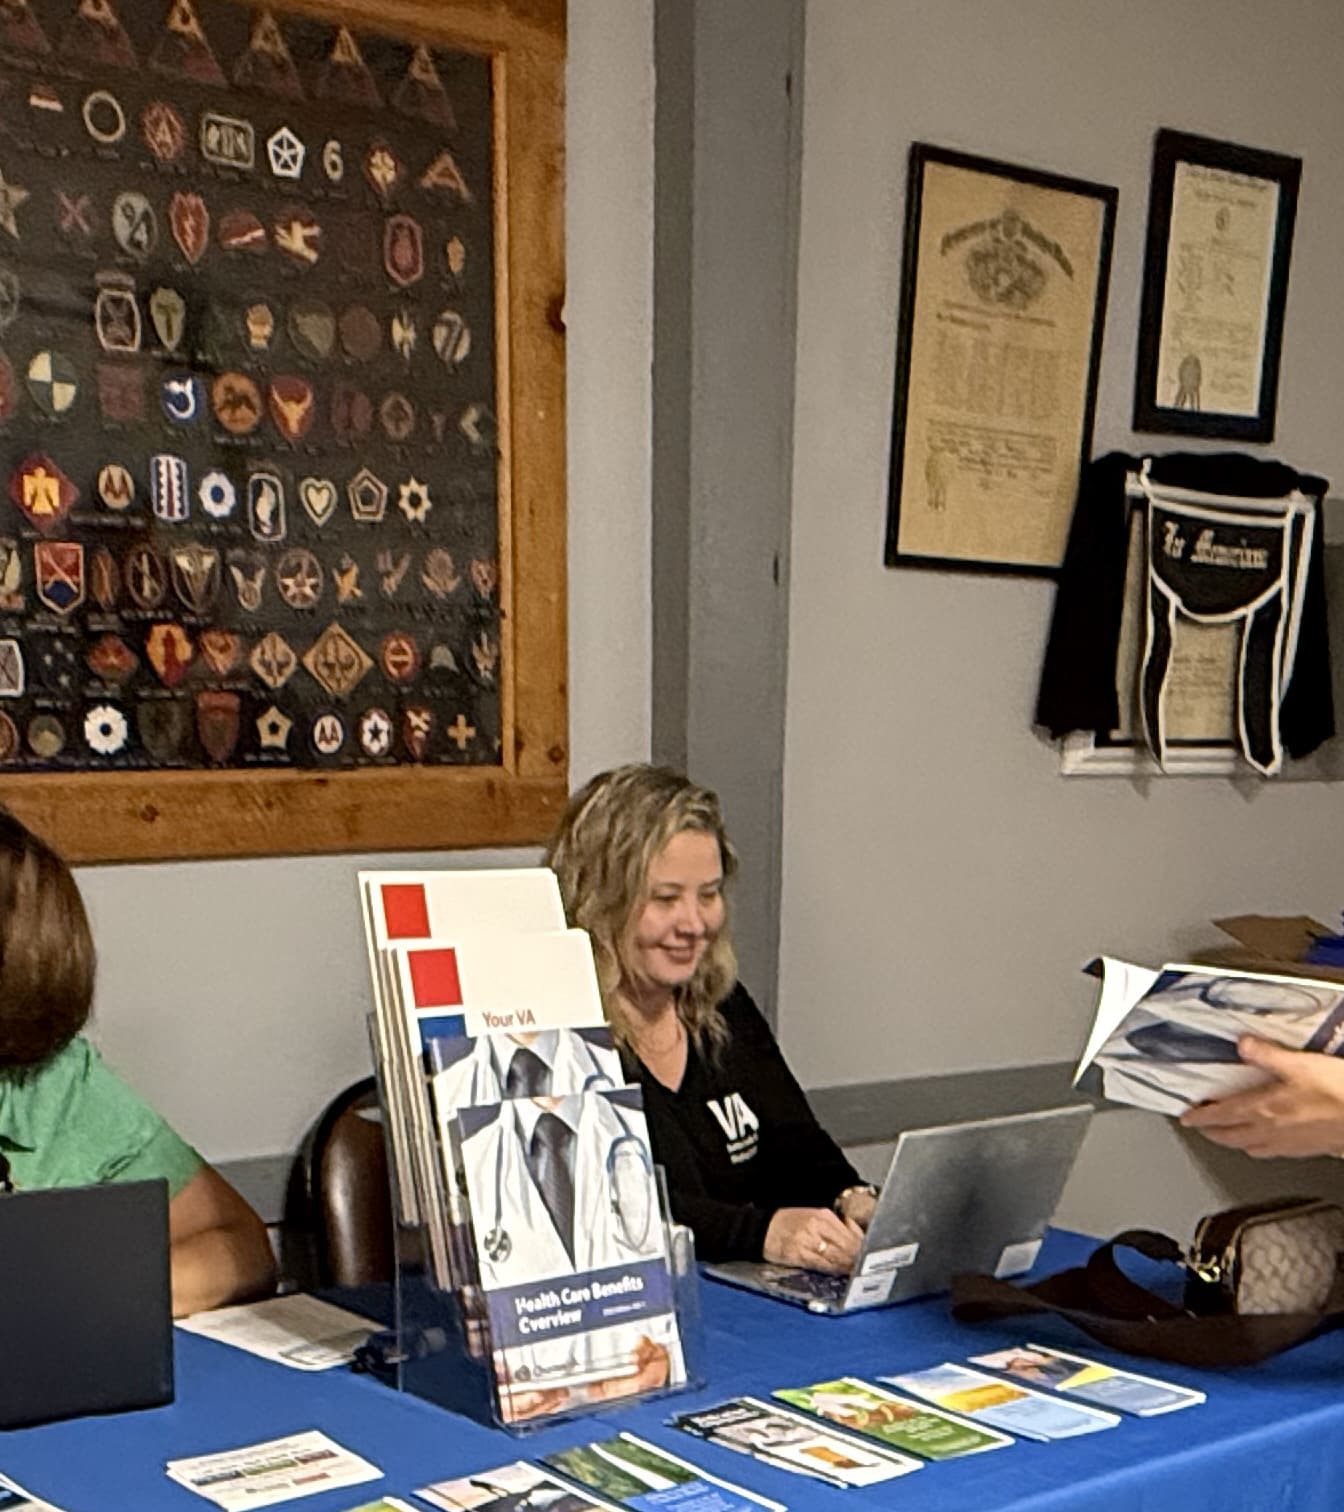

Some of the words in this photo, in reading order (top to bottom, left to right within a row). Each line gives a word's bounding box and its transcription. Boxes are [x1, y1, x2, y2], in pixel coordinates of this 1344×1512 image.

[482, 1010, 514, 1028] Your
[515, 1008, 536, 1026] VA
[706, 1092, 759, 1140] VA
[515, 1291, 561, 1315] Health
[560, 1287, 591, 1305] Care
[590, 1275, 644, 1300] Benefits
[518, 1309, 582, 1334] Overview
